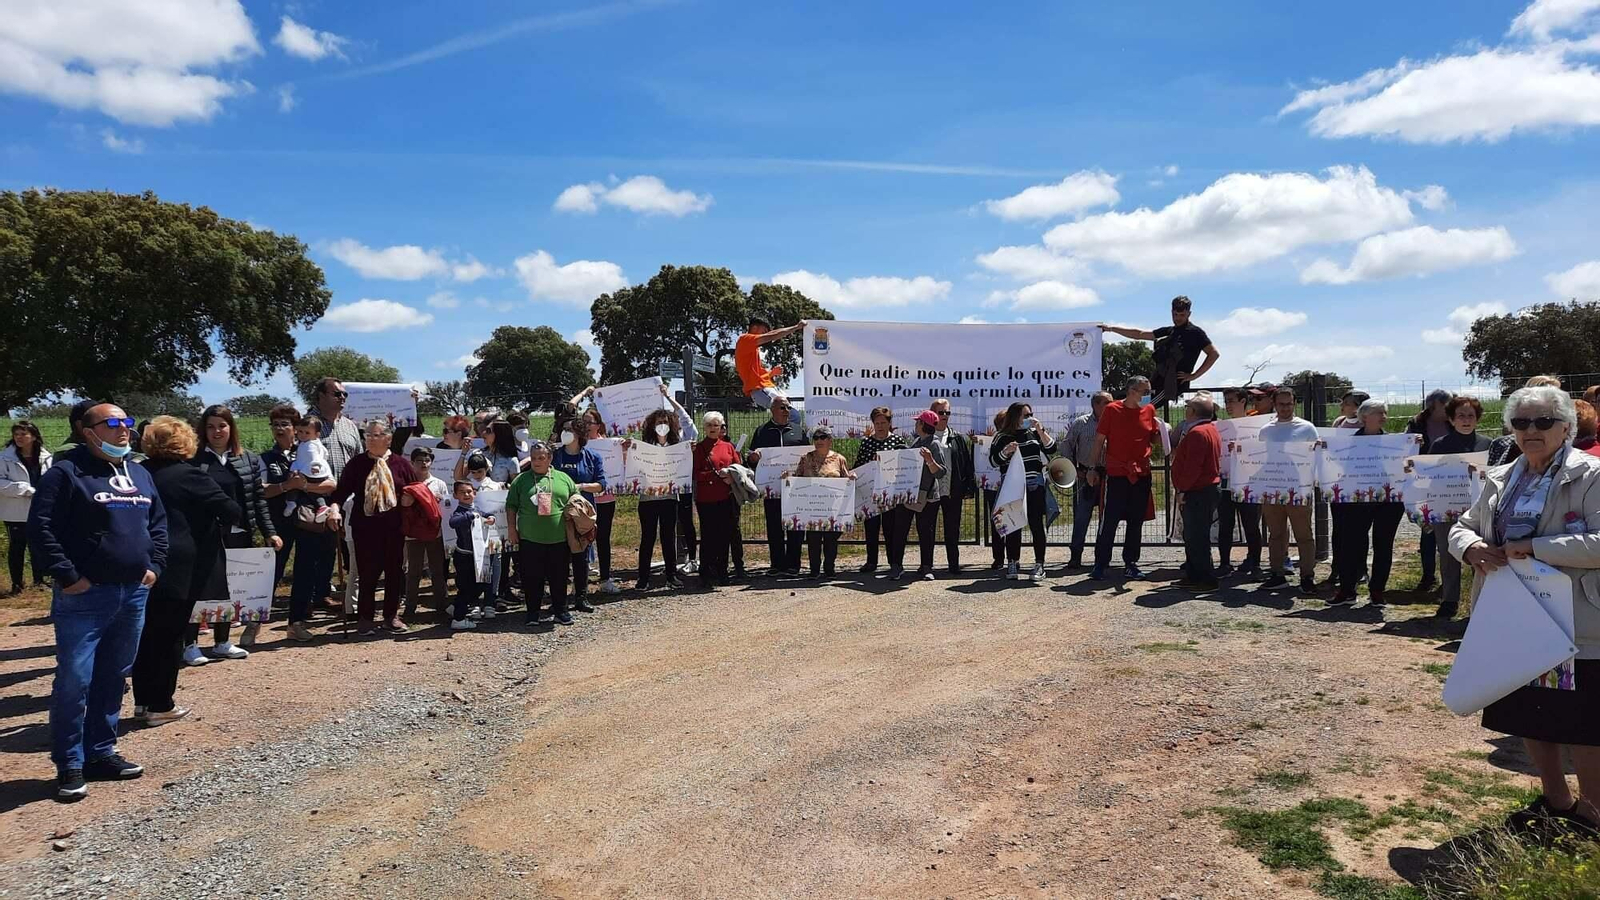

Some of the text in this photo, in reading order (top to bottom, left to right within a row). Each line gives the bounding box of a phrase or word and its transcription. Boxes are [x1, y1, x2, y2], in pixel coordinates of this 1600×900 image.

[819, 362, 1091, 384] Que nadie nos quite lo que es
[812, 384, 1092, 399] nuestro. Por una ermita libre.
